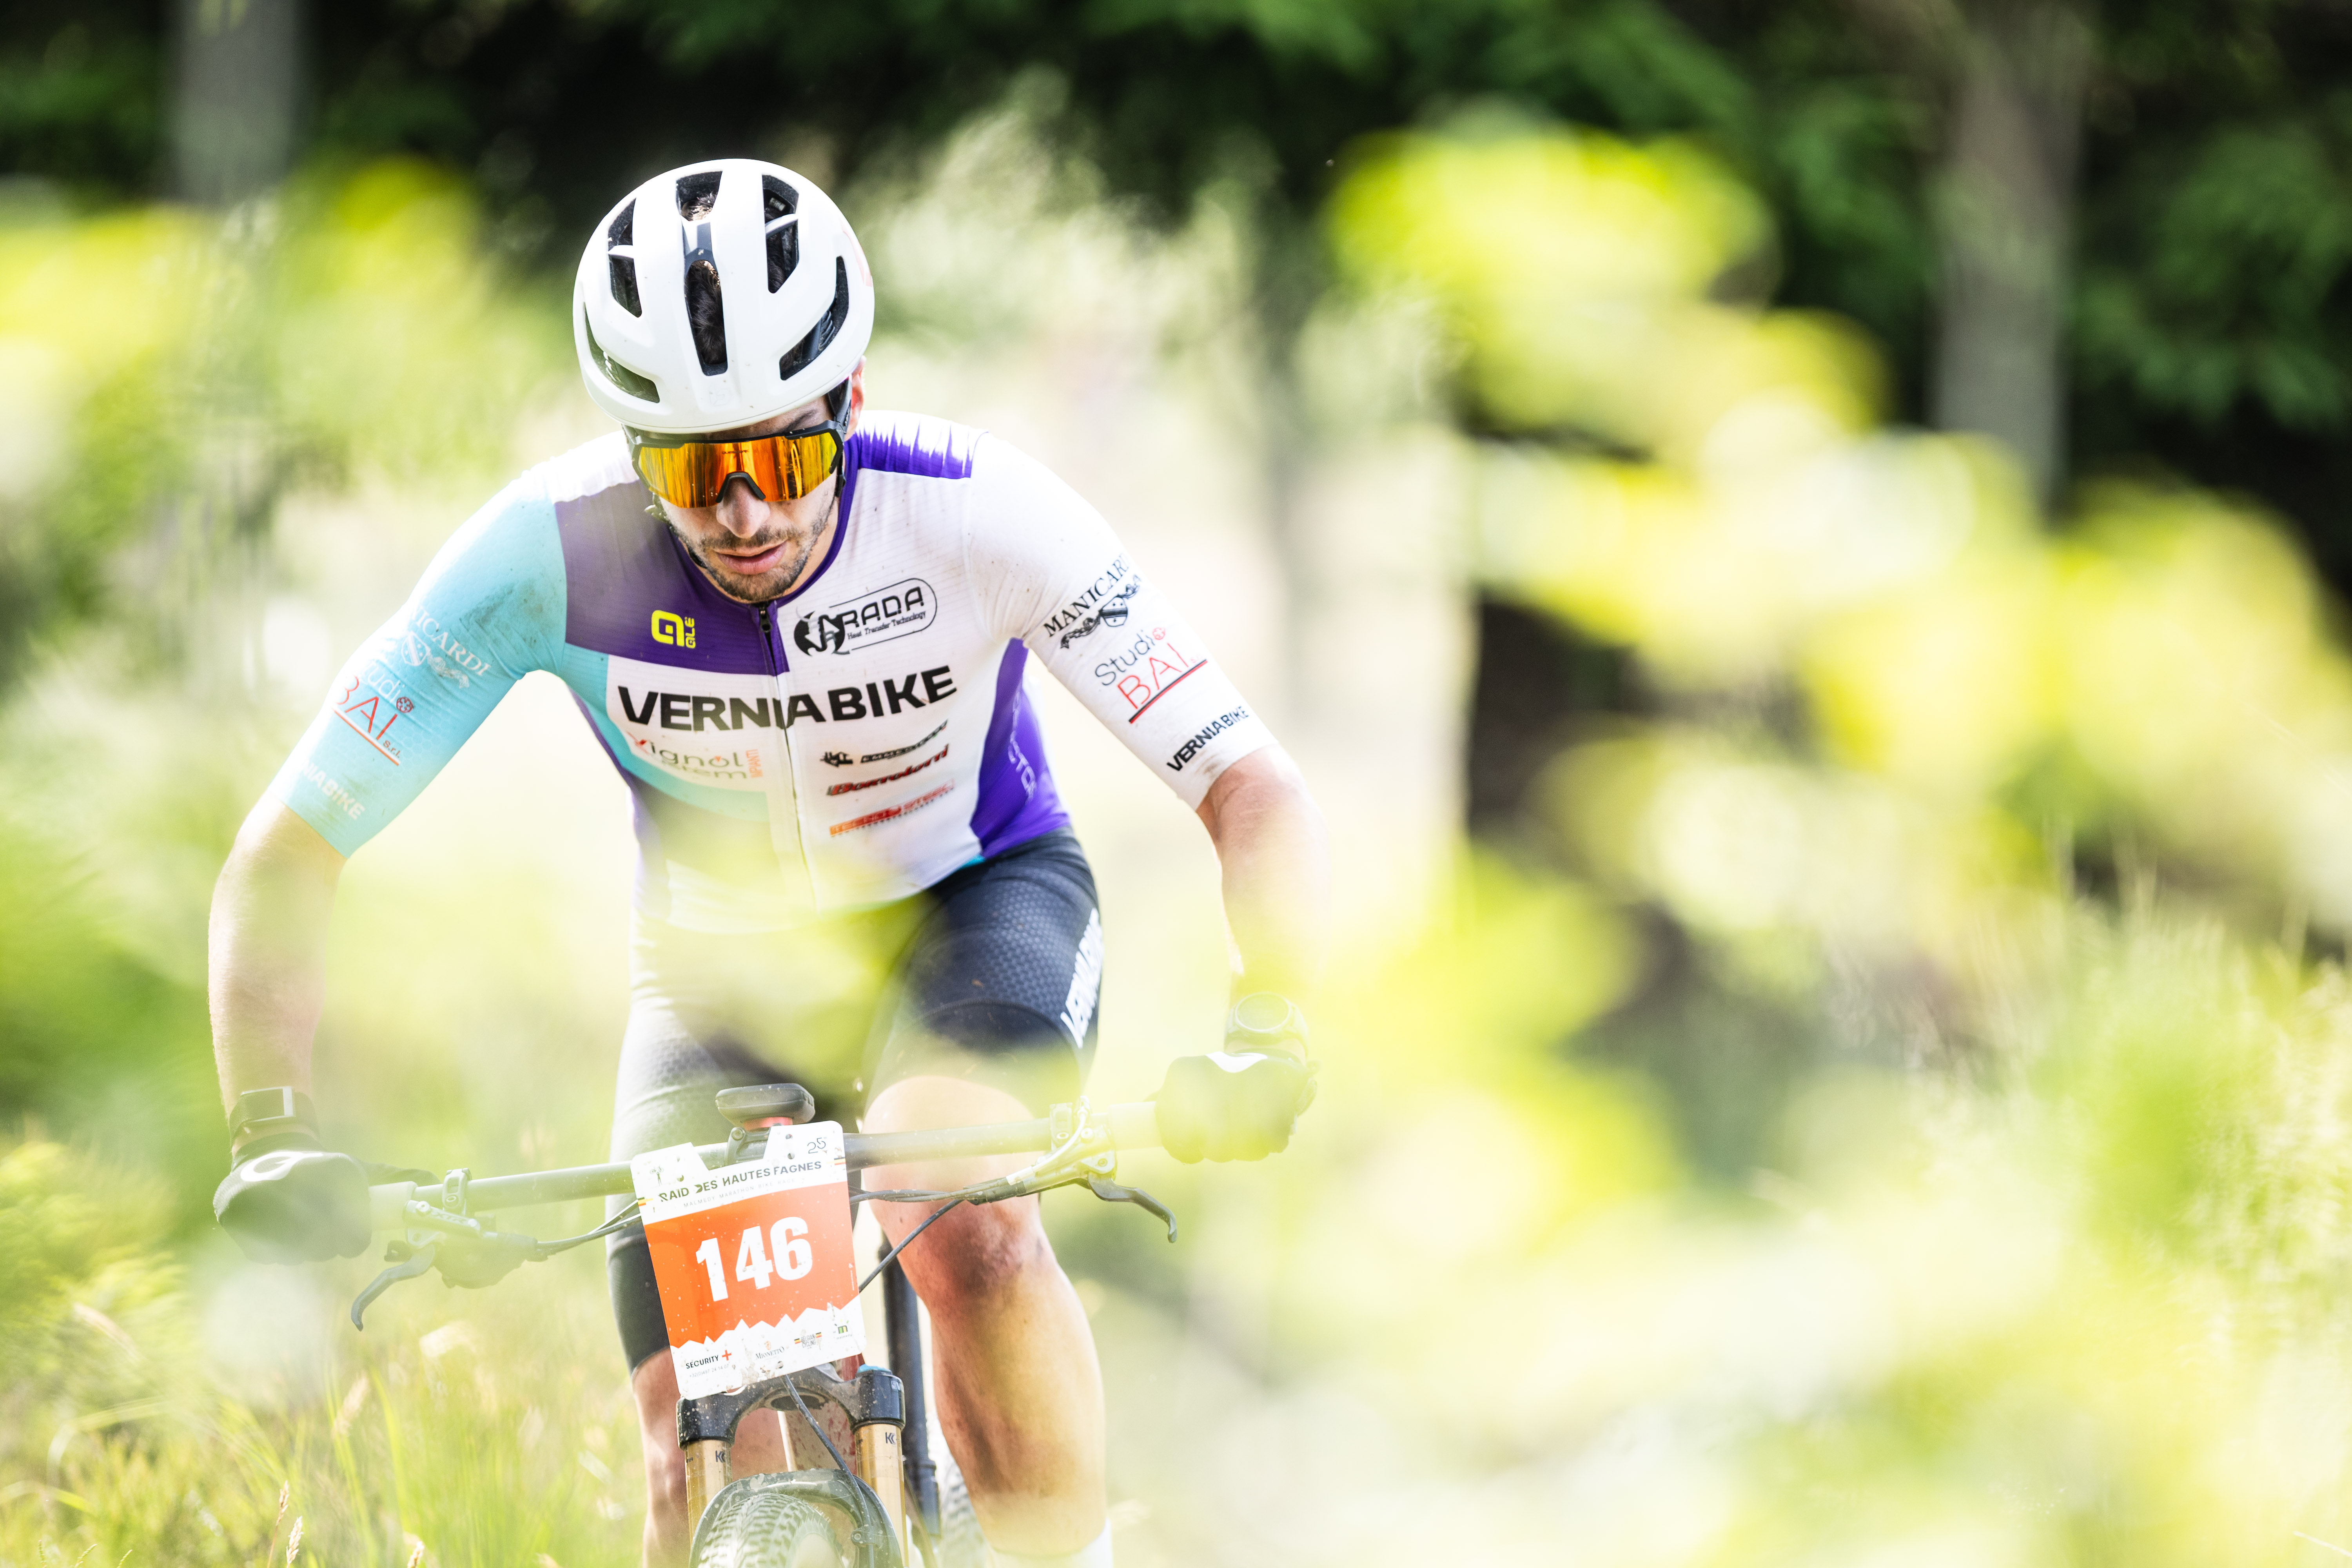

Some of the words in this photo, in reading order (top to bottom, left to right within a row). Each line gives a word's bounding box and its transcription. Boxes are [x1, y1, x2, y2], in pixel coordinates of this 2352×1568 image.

[865, 622, 891, 634] Transfer
[891, 611, 926, 626] Technology
[1042, 553, 1131, 637] MANICAR
[412, 605, 491, 676] NICARDI
[618, 665, 957, 731] VERNIABIKE
[1167, 706, 1249, 771] VERNIABIKE
[300, 761, 365, 820] NIABIKE
[807, 1138, 826, 1154] 25
[658, 1187, 689, 1202] RAID
[723, 1168, 770, 1186] HAUTES
[773, 1161, 822, 1175] FAGNES
[684, 1196, 715, 1207] MALMEDY
[719, 1186, 754, 1198] MARATHON
[695, 1216, 813, 1302] 146
[686, 1355, 719, 1369] SECURITY
